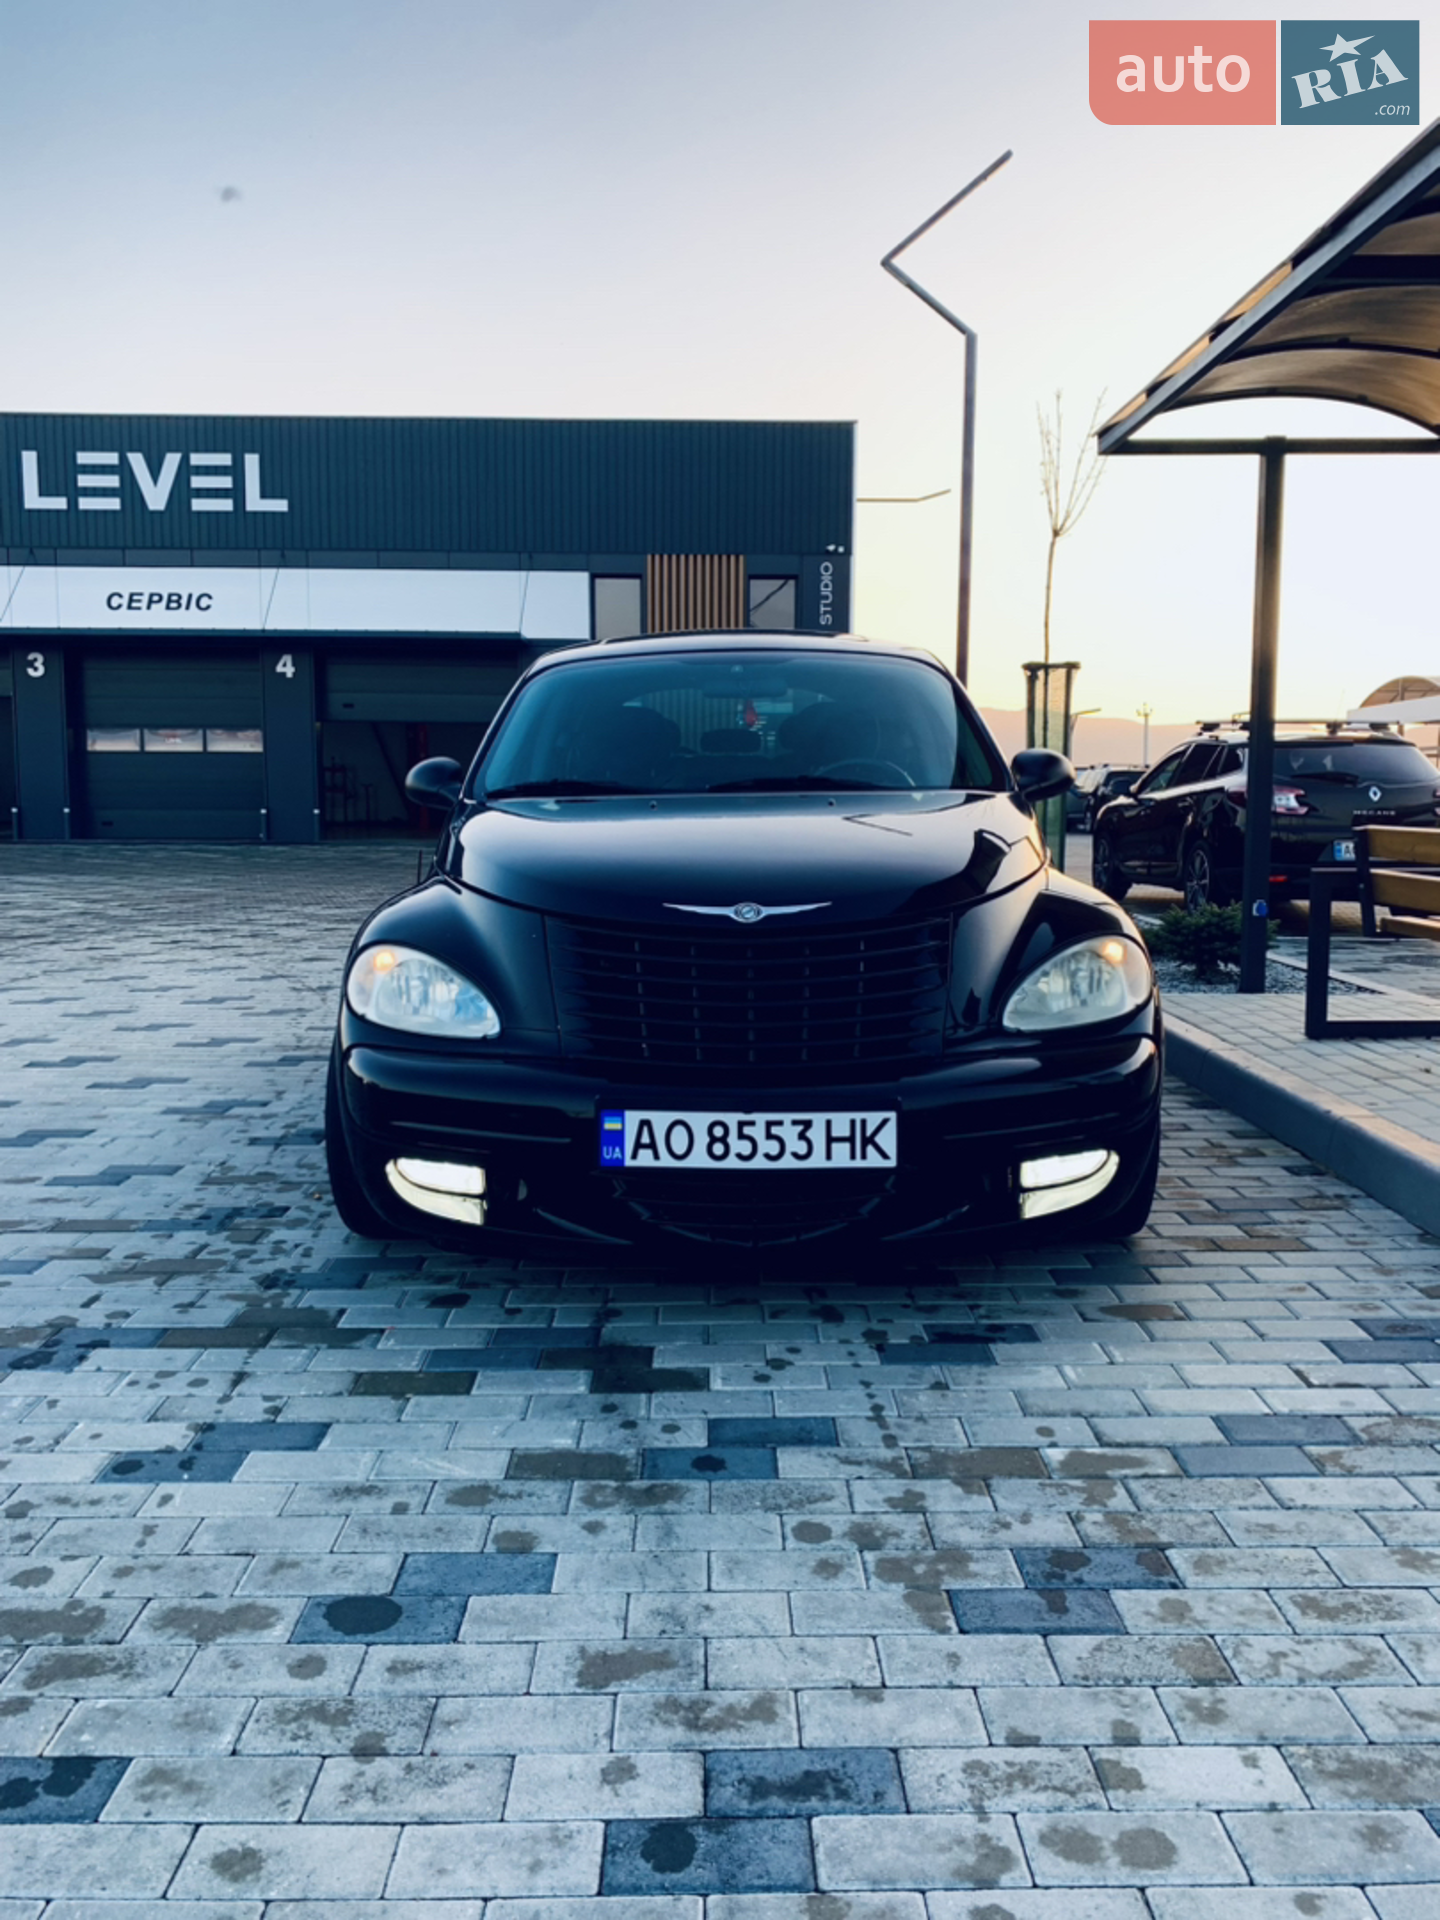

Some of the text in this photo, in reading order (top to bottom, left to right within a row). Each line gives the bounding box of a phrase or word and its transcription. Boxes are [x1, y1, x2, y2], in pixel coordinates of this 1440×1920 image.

[21, 450, 289, 512] LEVEL
[106, 591, 214, 612] СЕРВІС
[819, 561, 834, 626] STUDIO
[26, 652, 46, 678] 3
[275, 654, 296, 678] 4
[630, 1117, 892, 1162] AO 8553 HK
[603, 1146, 622, 1160] UA
